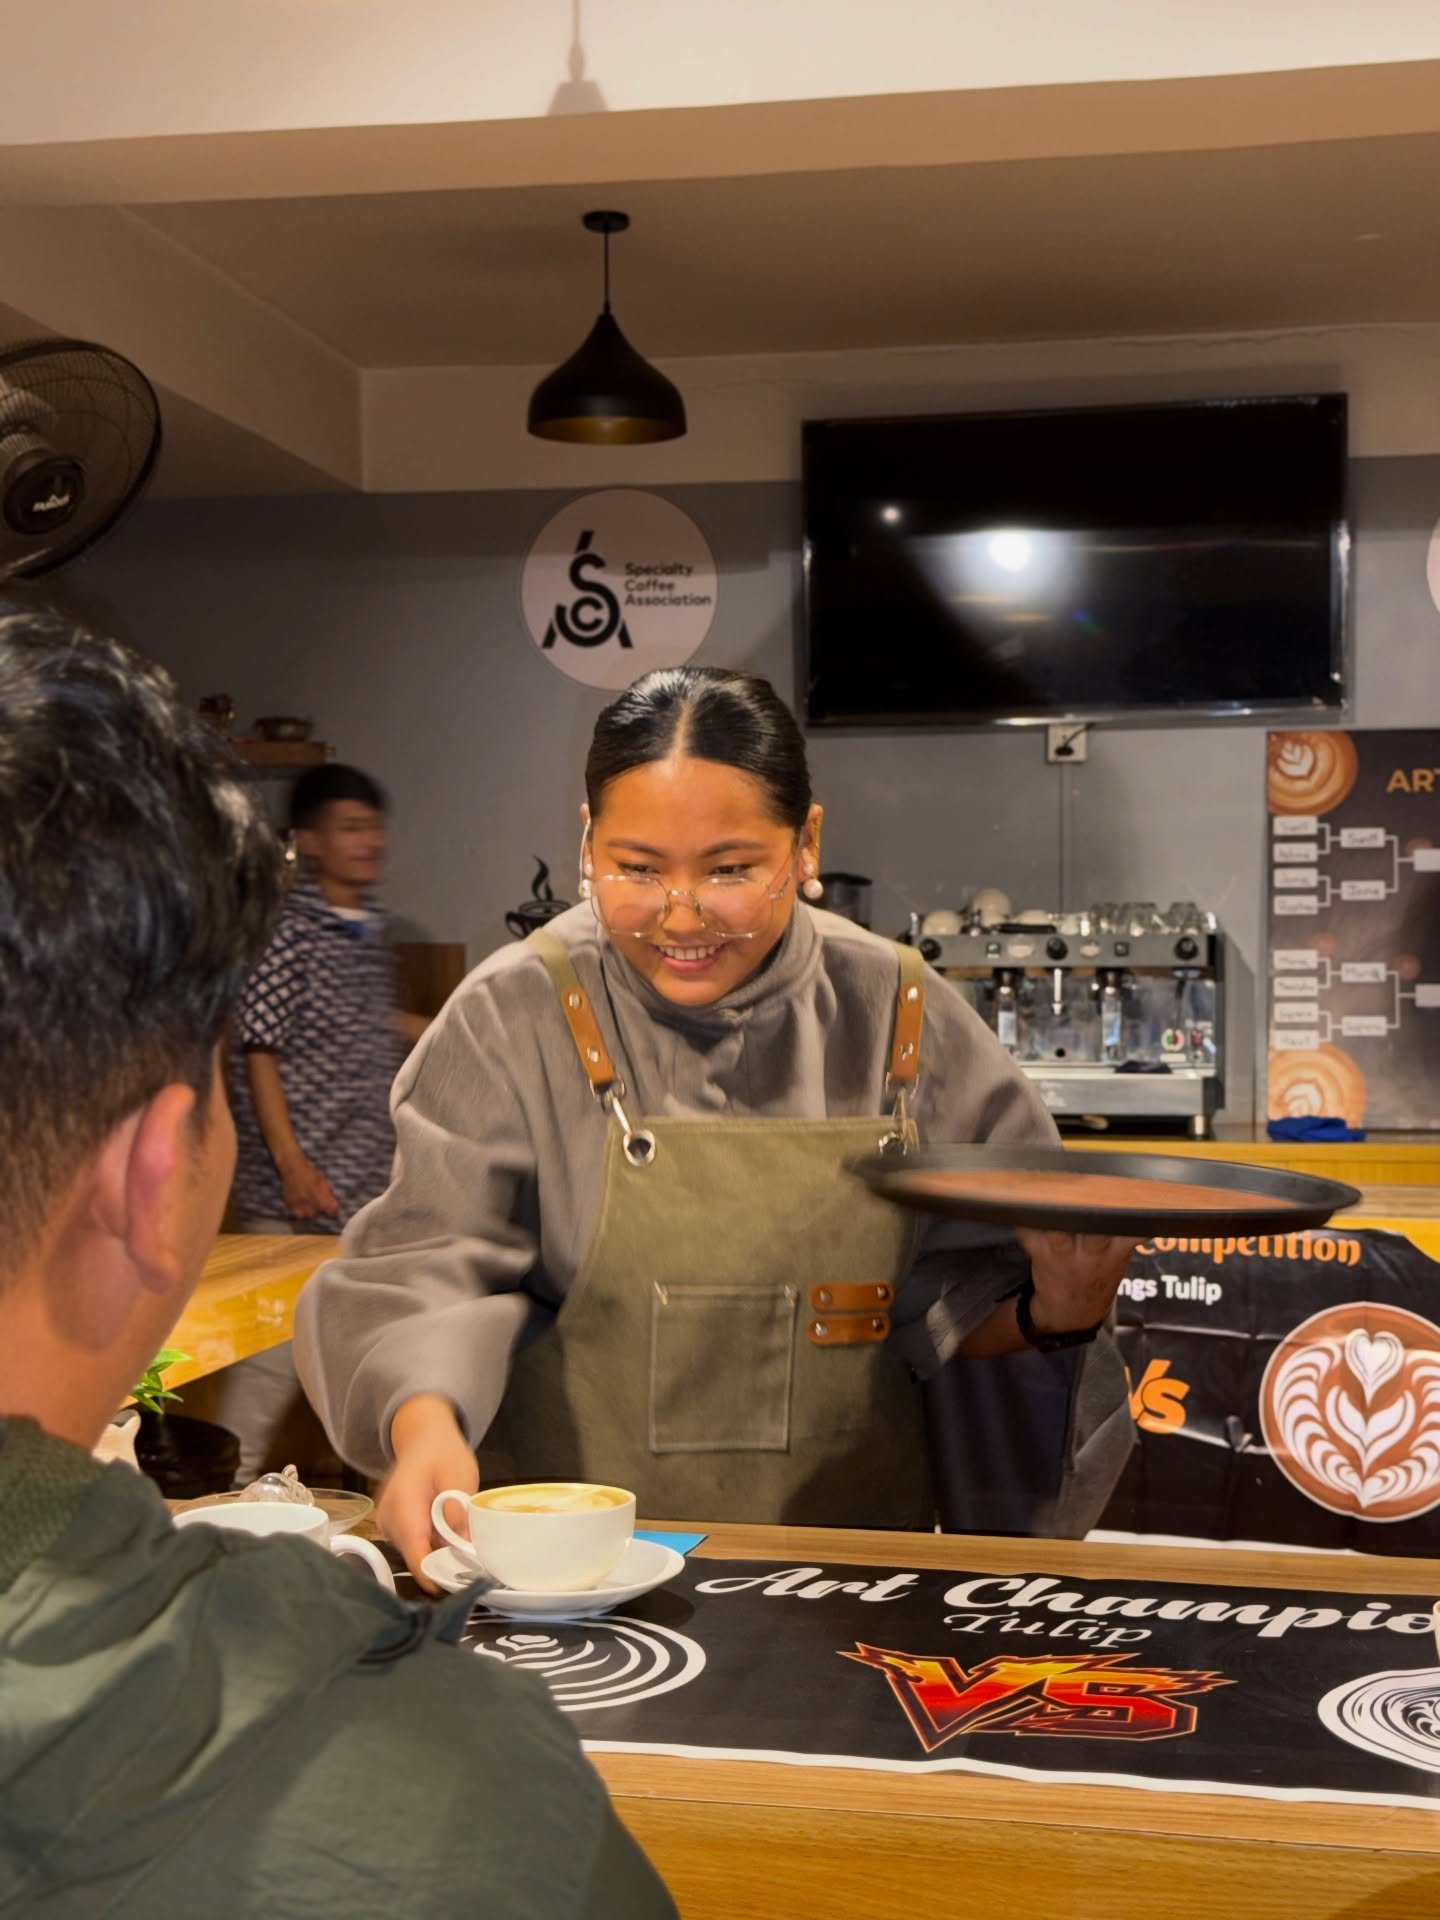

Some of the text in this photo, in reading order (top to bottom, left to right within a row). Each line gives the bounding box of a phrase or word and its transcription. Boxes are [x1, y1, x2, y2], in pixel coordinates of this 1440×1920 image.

[624, 562, 693, 578] Specialty
[624, 579, 675, 592] Coffee
[624, 593, 711, 607] Association
[1117, 1275, 1222, 1306] ngs Tulip
[694, 1567, 920, 1602] Art
[943, 1611, 1152, 1648] Tulip
[836, 1641, 1239, 1752] VS
